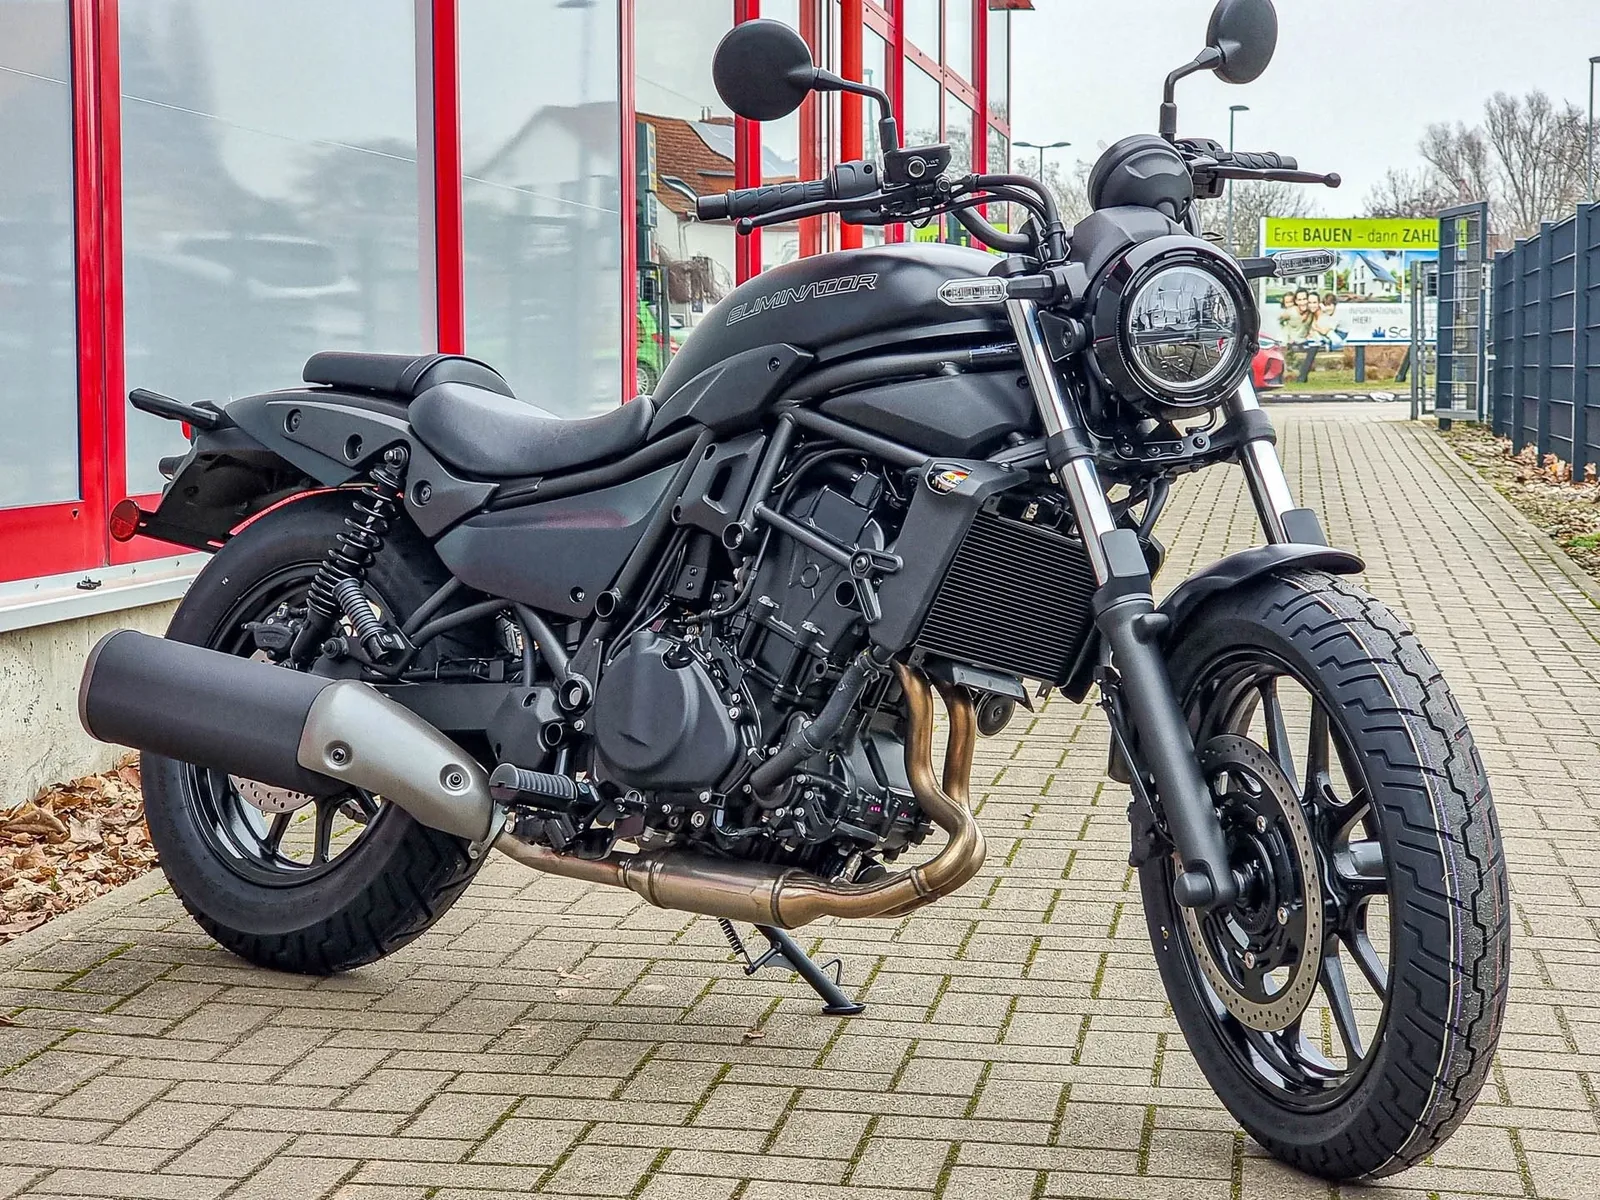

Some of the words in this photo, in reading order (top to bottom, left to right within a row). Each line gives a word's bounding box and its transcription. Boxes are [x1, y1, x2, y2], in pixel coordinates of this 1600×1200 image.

[1274, 227, 1298, 242] Erst
[1303, 228, 1352, 243] BAUEN
[1368, 228, 1398, 243] dann
[726, 273, 879, 327] ELIMINATOR
